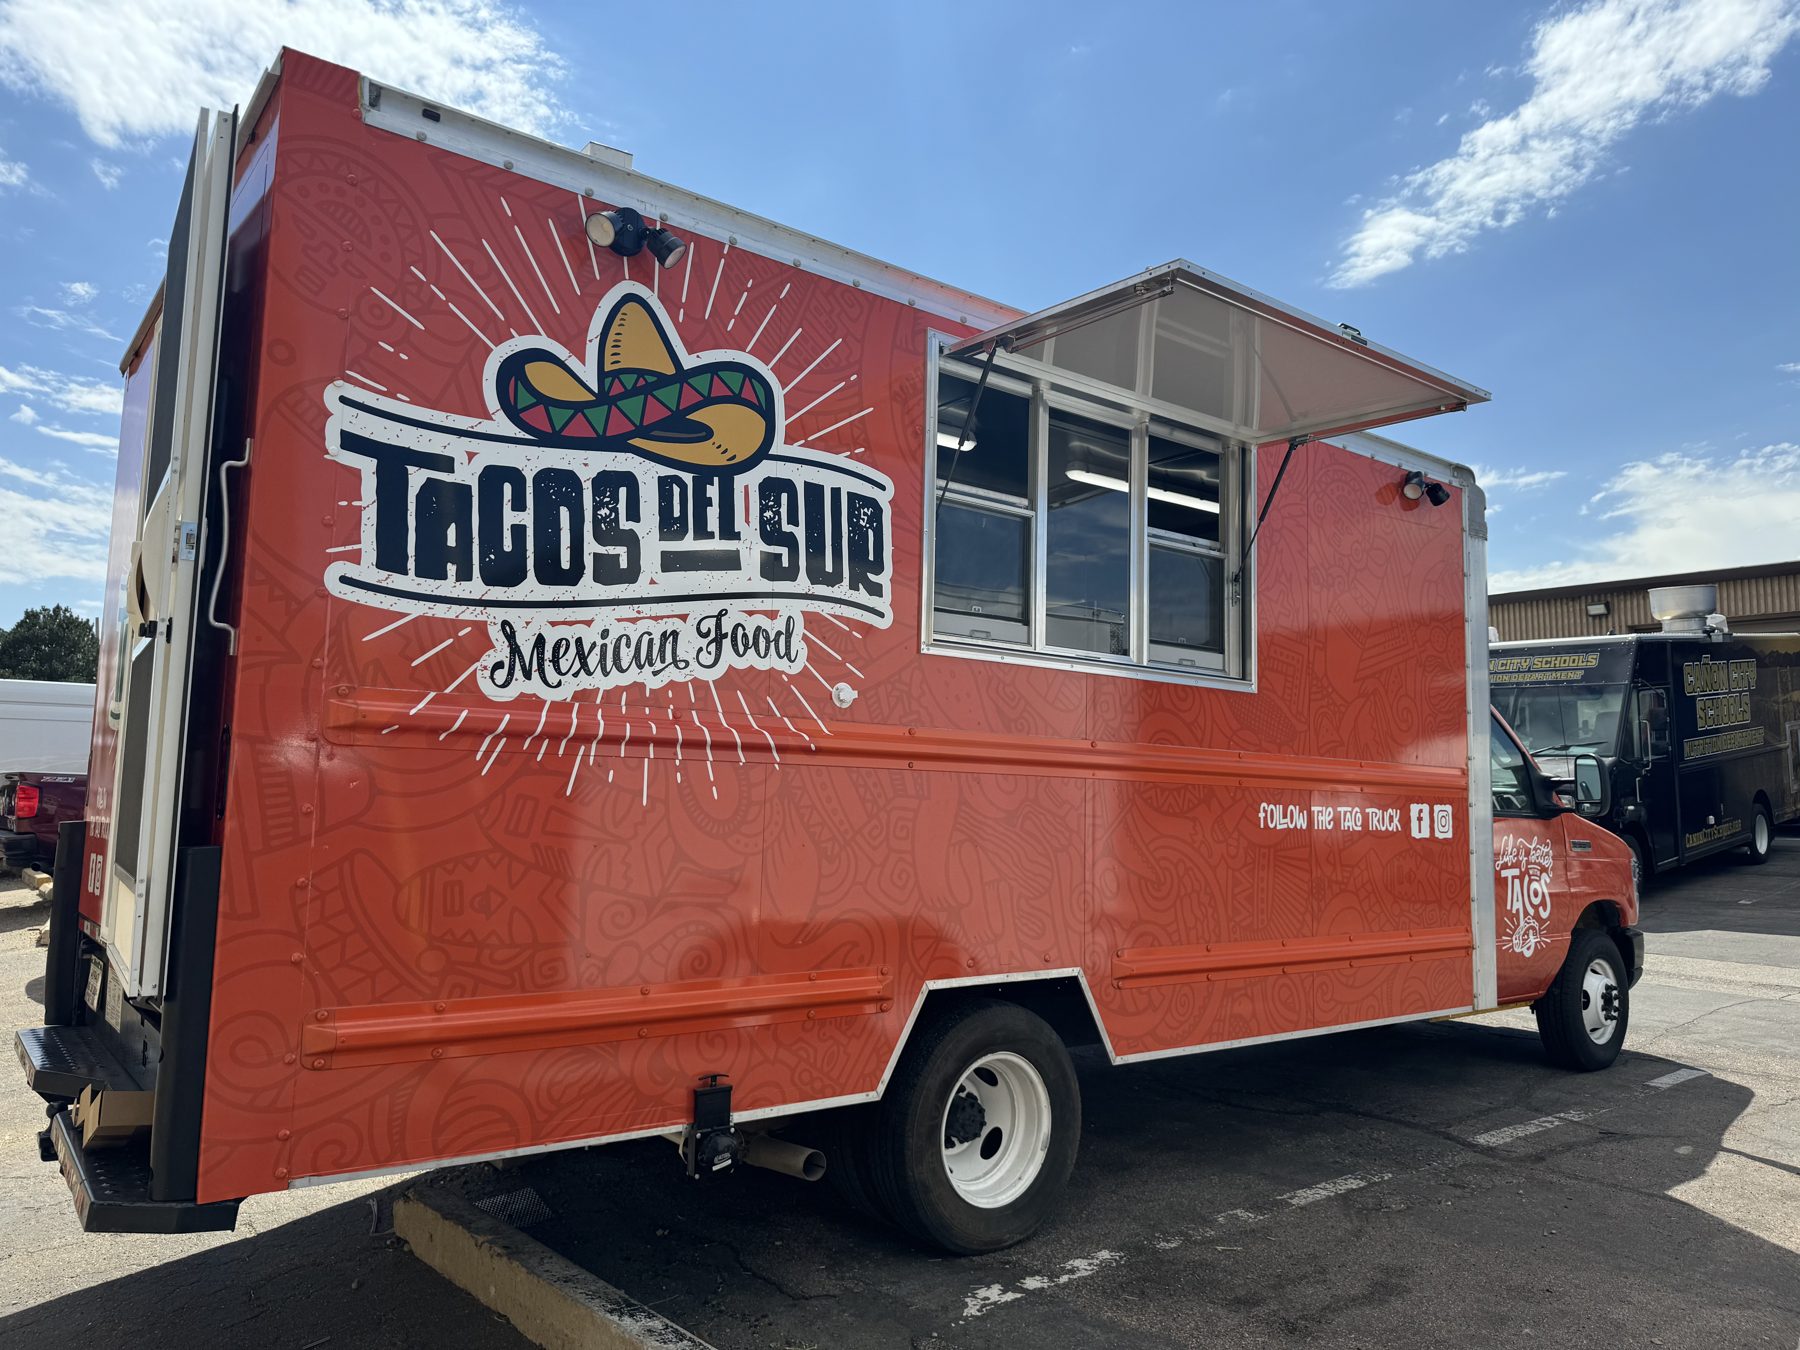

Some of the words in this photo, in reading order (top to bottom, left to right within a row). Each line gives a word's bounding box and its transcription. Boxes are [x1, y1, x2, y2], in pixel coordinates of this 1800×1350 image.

[340, 429, 641, 587] TACOS
[657, 474, 742, 542] DEL
[758, 476, 885, 598] SUR
[490, 620, 689, 689] Mexican
[696, 608, 799, 669] Food
[1496, 656, 1532, 672] CITY
[1532, 653, 1599, 670] SCHOOLS
[1512, 670, 1584, 681] DEPARTMENT
[1729, 659, 1757, 691] CITY
[1697, 692, 1750, 730] SCHOOLS
[1337, 806, 1362, 831] TACO
[1365, 807, 1401, 832] TRUCK
[1495, 834, 1517, 871] Life
[1518, 844, 1528, 871] is
[1521, 836, 1553, 875] better
[1501, 868, 1551, 919] TACOS
